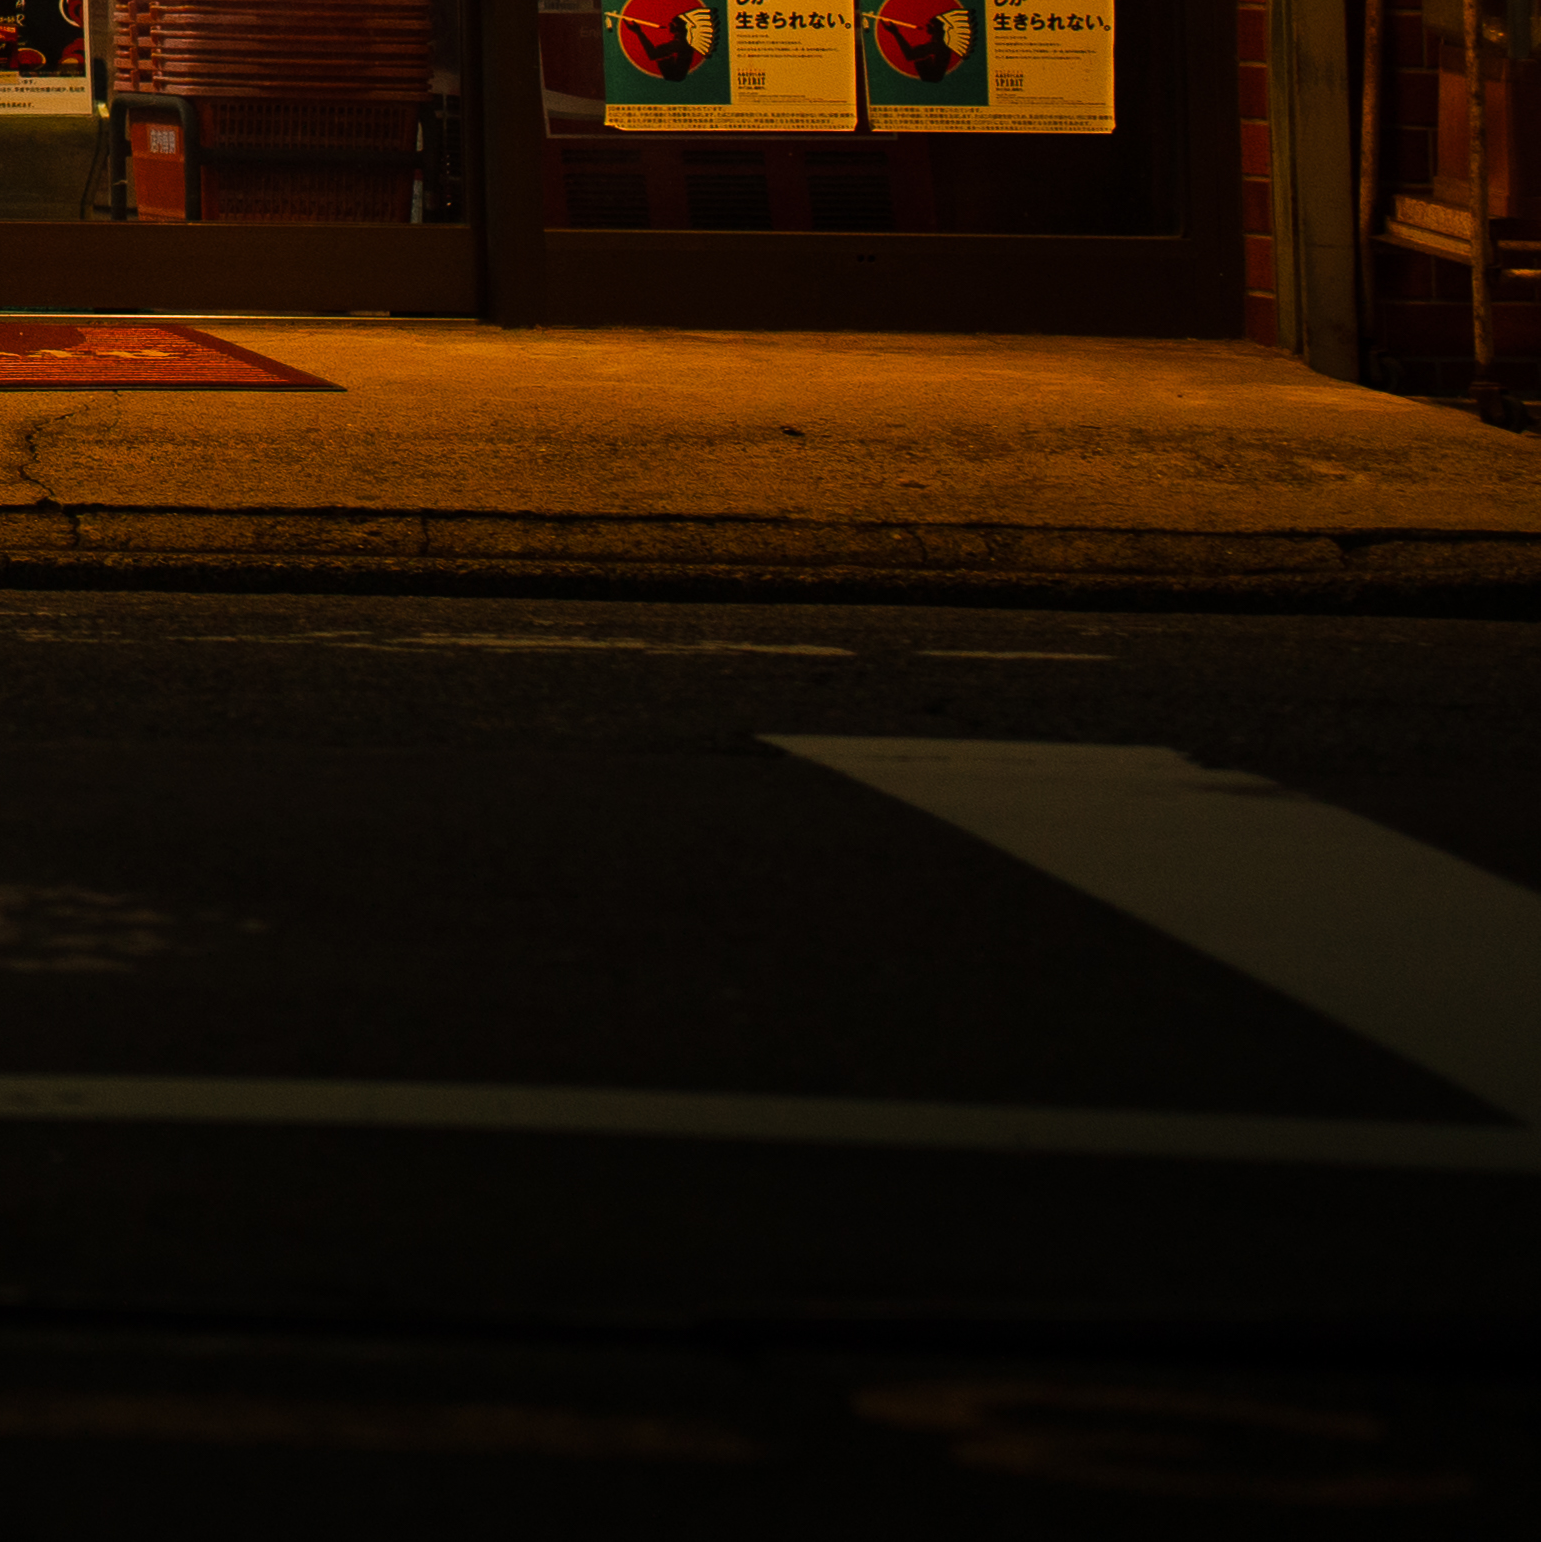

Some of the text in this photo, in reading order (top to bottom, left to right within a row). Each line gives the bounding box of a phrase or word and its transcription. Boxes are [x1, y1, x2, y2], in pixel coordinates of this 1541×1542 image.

[735, 10, 852, 31] 生きられない。
[993, 11, 1111, 32] 生きられない。
